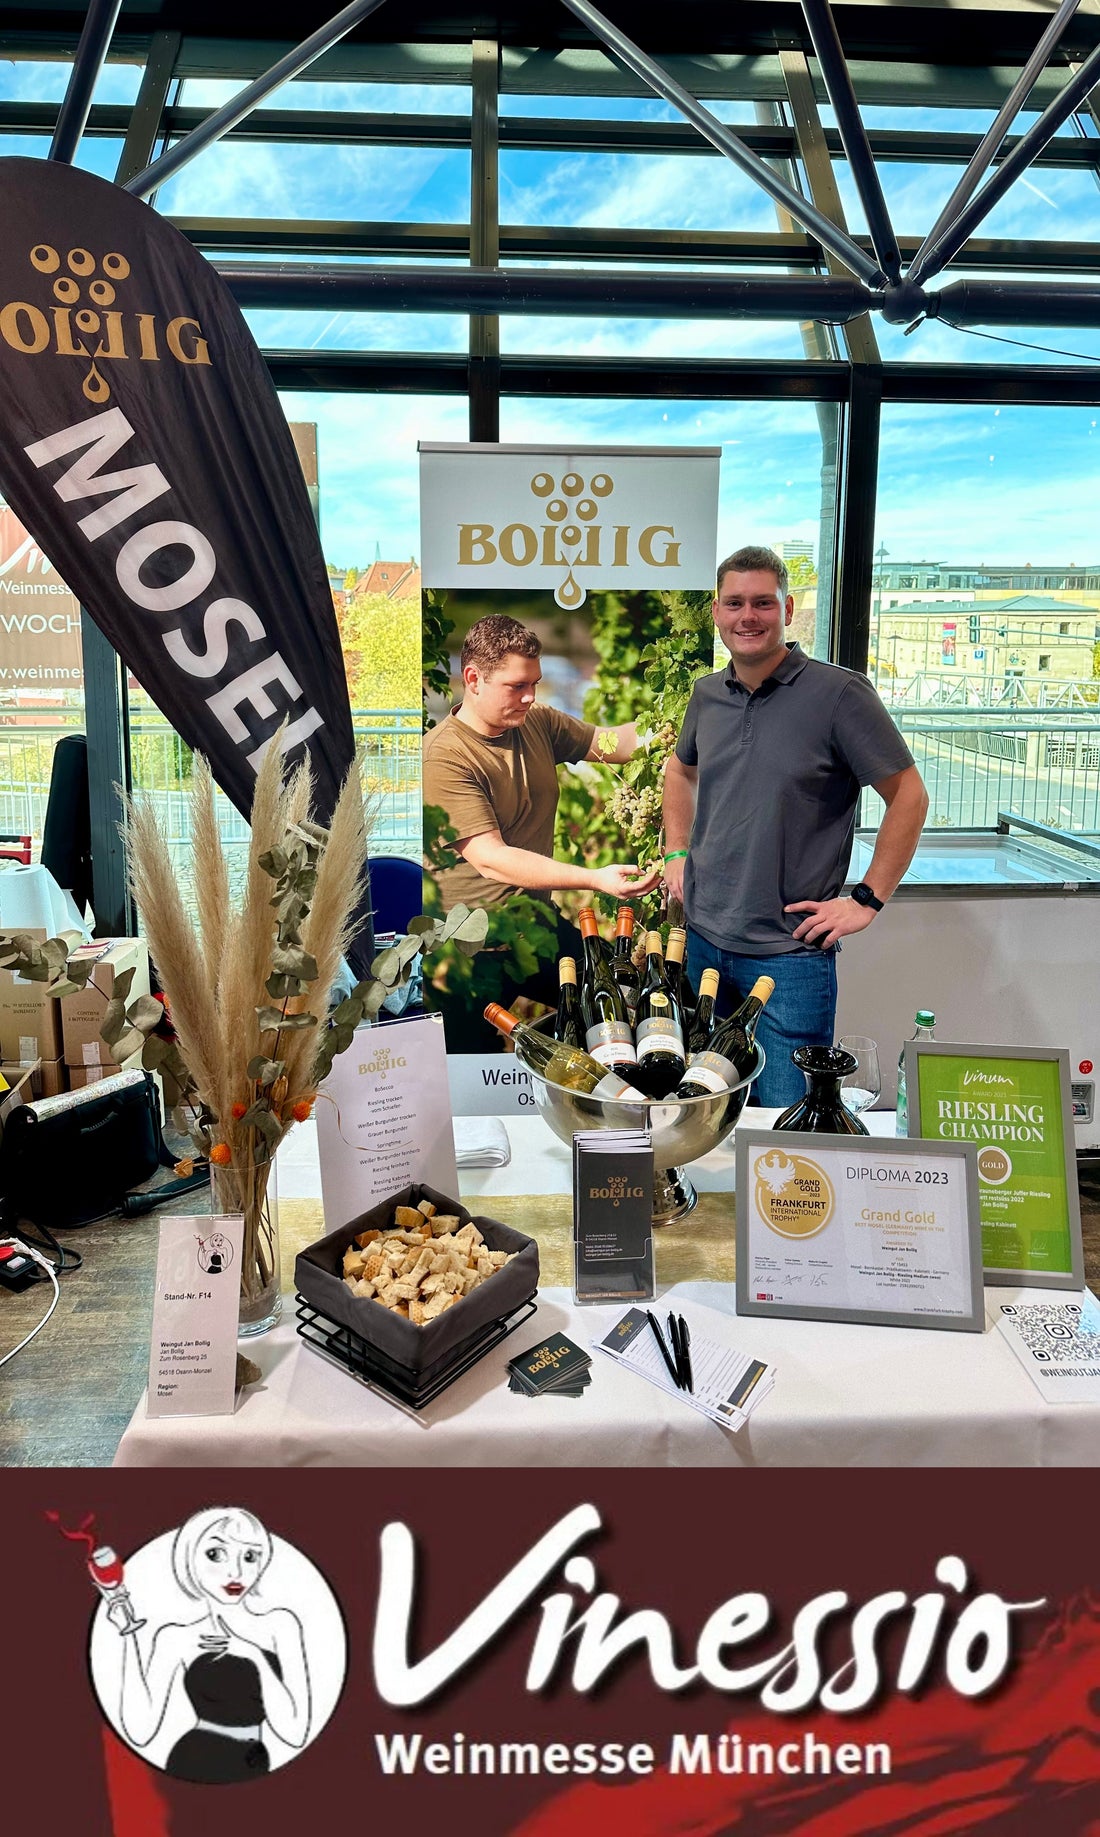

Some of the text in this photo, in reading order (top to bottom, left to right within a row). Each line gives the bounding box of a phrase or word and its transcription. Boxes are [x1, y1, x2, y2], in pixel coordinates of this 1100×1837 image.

[457, 523, 681, 566] BOLLIG
[358, 1056, 407, 1074] BOLLIG
[367, 1095, 403, 1107] Riesling trocken
[938, 1100, 1044, 1124] RIESLING
[939, 1121, 1044, 1142] CHAMPION
[982, 1161, 1004, 1169] GOLD
[846, 1166, 949, 1185] DIPLOMA 2023
[589, 1187, 644, 1199] BOLLIG
[770, 1198, 826, 1210] FRANKFURT
[770, 1207, 821, 1217] INTERNATIONAL
[861, 1208, 935, 1225] Grand Gold
[163, 1291, 212, 1301] Stand-Nr. F14
